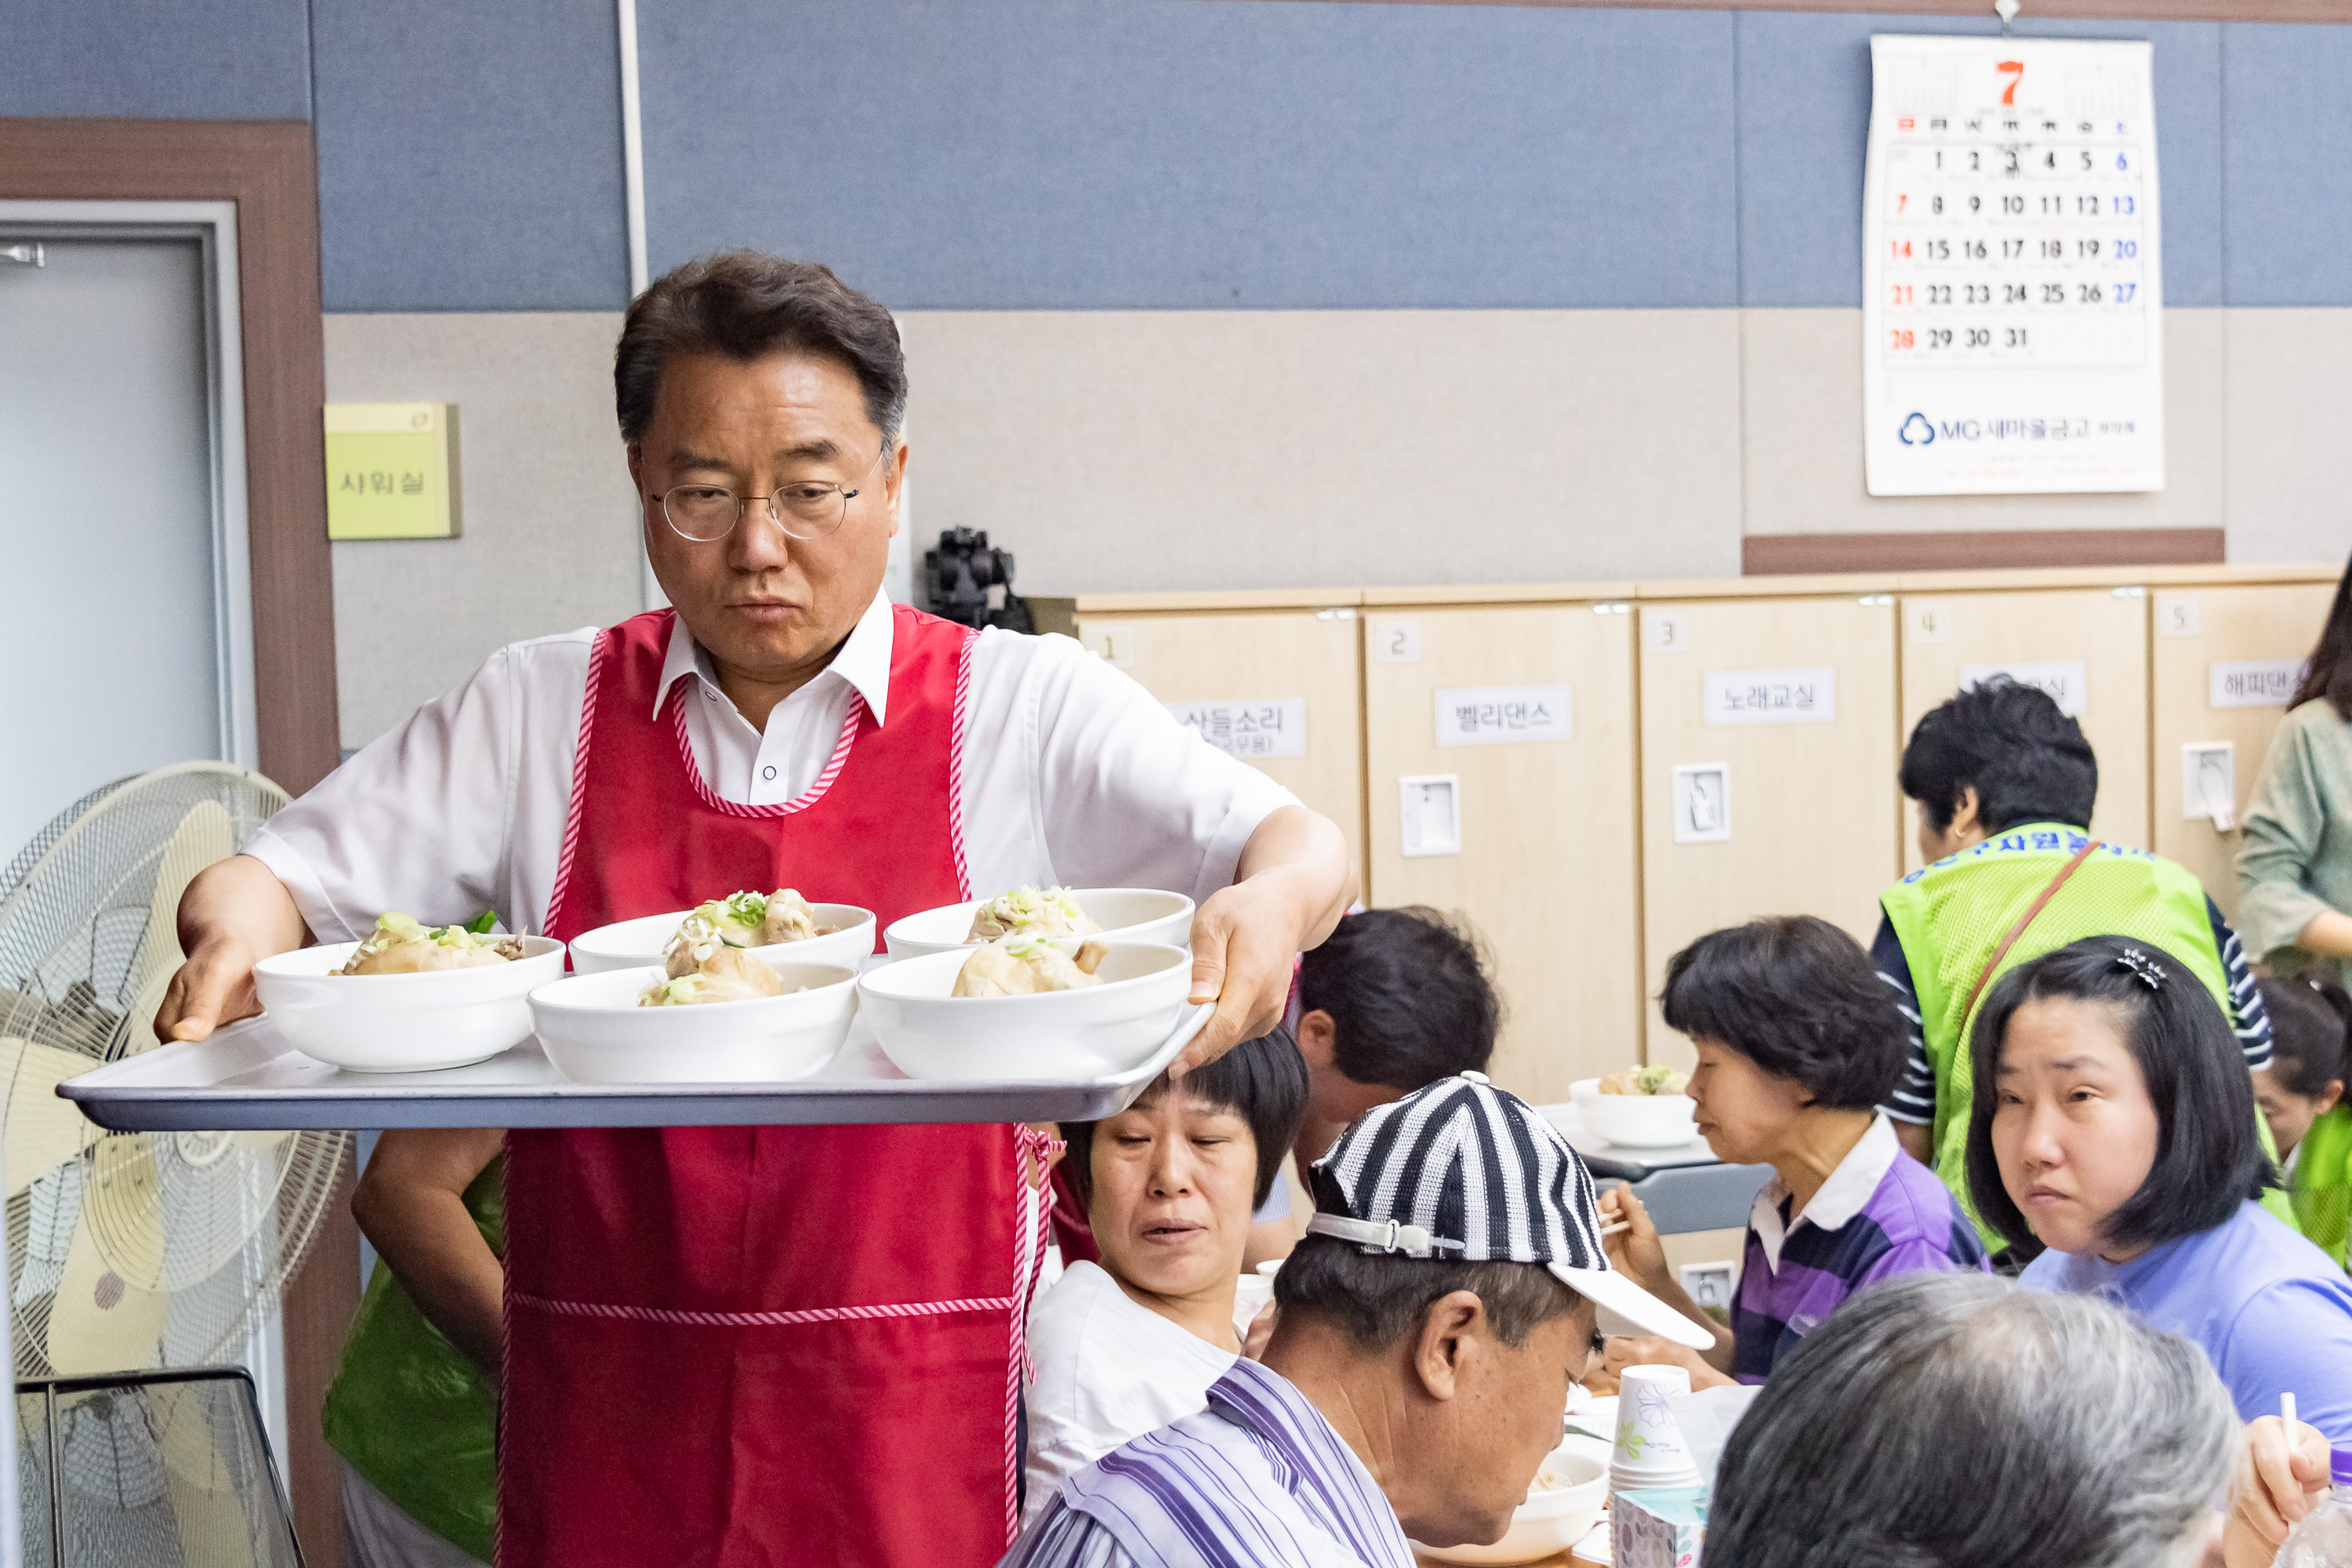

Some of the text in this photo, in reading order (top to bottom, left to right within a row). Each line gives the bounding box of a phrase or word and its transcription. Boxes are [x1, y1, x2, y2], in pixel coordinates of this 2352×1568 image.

[1996, 60, 2024, 107] 7
[1935, 151, 1943, 170] 1
[1969, 151, 1980, 171] 2
[2043, 151, 2056, 170] 4
[2080, 151, 2093, 171] 5
[2116, 152, 2129, 172] 6
[1896, 194, 2135, 215] 7 8 9 10 11 12 13
[1891, 240, 2138, 260] 14 15 16 17 18 19 20
[1891, 283, 2137, 304] 21 22 23 24 25 26 27
[1889, 328, 2027, 349] 28 29 30 31
[1922, 612, 1936, 634] 4
[2173, 605, 2187, 630] 5
[1391, 630, 1406, 655] 2
[1662, 621, 1675, 647] 3
[1104, 634, 1116, 660] 1
[2224, 670, 2294, 699] 해피댄
[1723, 684, 1814, 711] 노래교실
[1455, 702, 1552, 732] 벨리댄스
